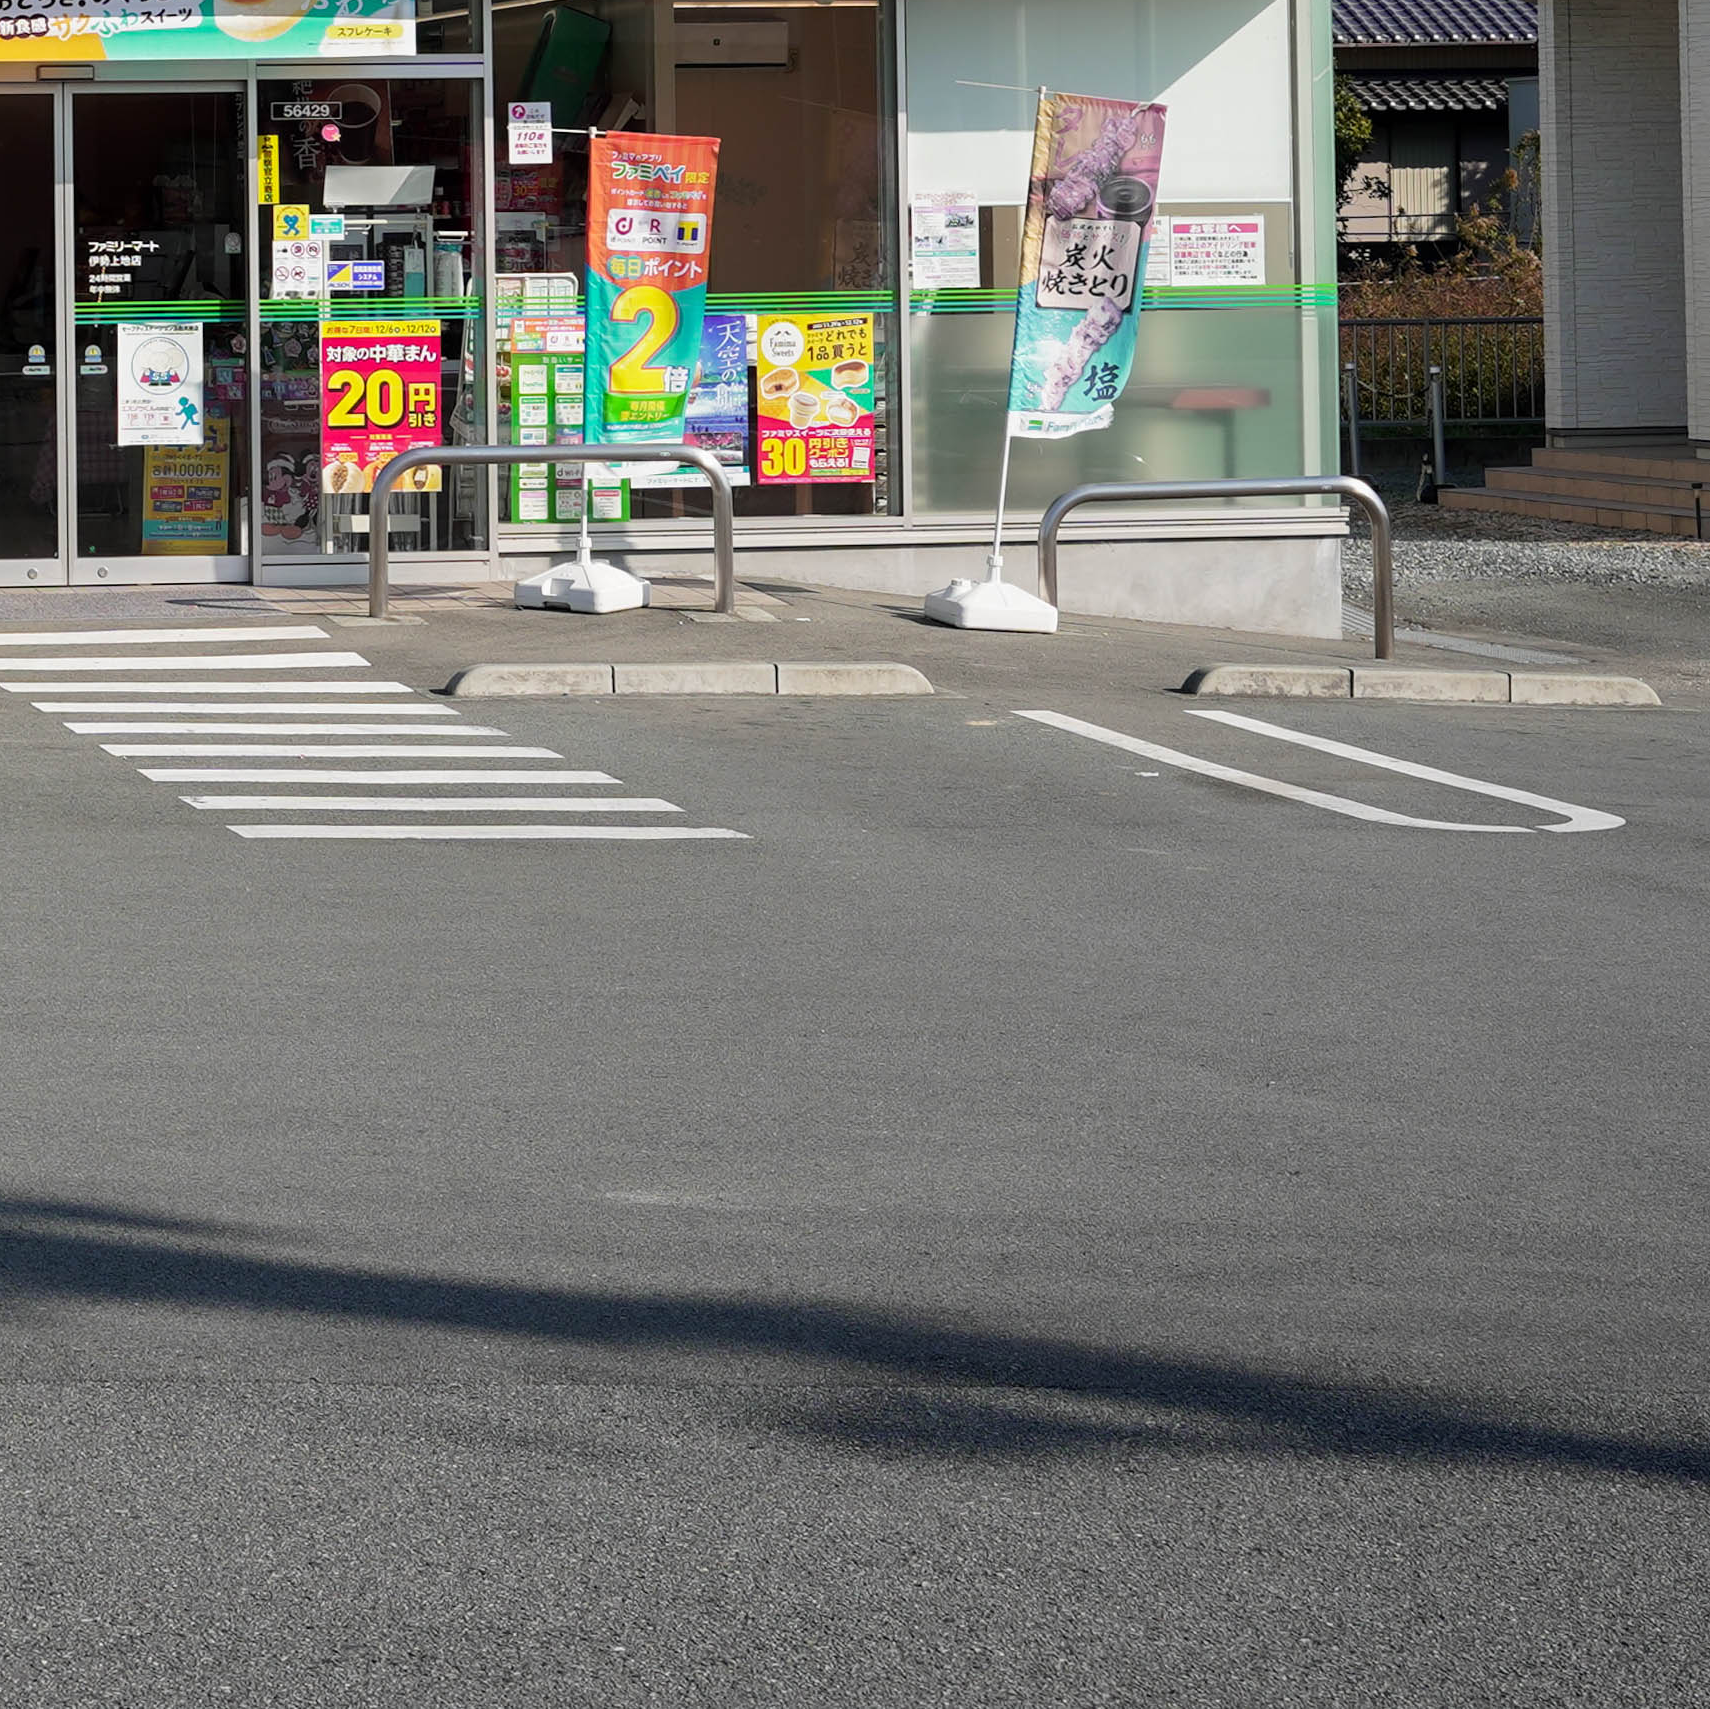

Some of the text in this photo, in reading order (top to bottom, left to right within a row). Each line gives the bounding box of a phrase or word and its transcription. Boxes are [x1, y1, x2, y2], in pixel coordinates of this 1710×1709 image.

[337, 26, 393, 37] スフレケーキ
[283, 105, 330, 117] 56429
[611, 162, 685, 183] ファミペイ
[88, 240, 159, 252] ファミリーマート
[642, 237, 668, 245] POINT
[1060, 243, 1115, 270] 炭火
[609, 257, 702, 279] 毎日ポイント
[1042, 270, 1128, 298] 焼きとり
[769, 338, 796, 348] Famima
[826, 327, 867, 342] どれでも
[326, 344, 437, 363] 対象の中華まん
[772, 348, 795, 357] Sweets
[807, 342, 867, 362] 1品買うと
[1083, 362, 1120, 402] 塩
[327, 369, 404, 427] 20
[761, 437, 807, 477] 30
[809, 449, 849, 458] クーポン
